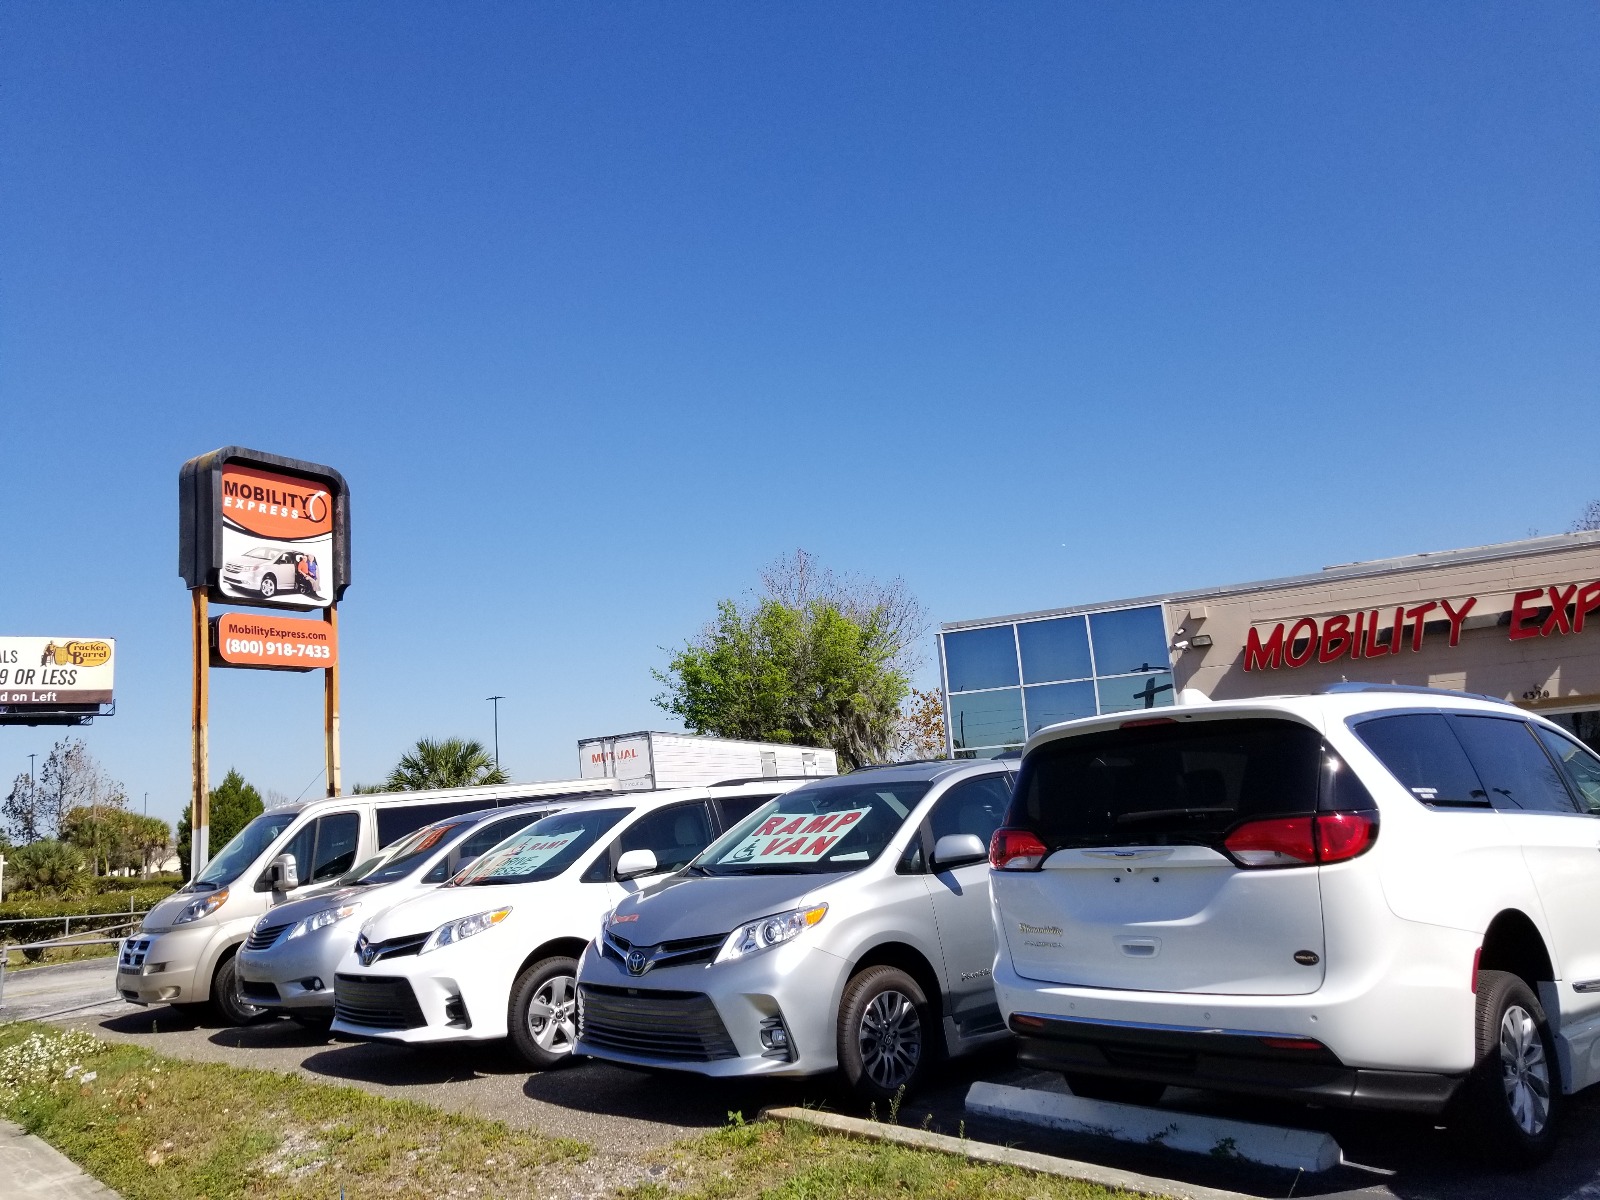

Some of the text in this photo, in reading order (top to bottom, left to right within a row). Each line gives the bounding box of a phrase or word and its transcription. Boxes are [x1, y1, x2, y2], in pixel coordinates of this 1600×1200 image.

[224, 480, 309, 510] MOBILITY
[224, 497, 299, 519] EXPRESS
[228, 623, 327, 640] MobilityExpress.com
[1243, 597, 1478, 672] MOBILITY
[66, 641, 107, 657] Cracker
[72, 651, 107, 665] Barrel
[225, 638, 330, 659] (800) 918-7433
[14, 668, 36, 685] OR
[41, 669, 78, 685] LESS
[12, 693, 28, 702] on
[31, 691, 57, 702] Left
[591, 748, 638, 764] MUTUAL
[751, 811, 862, 837] RAMP
[760, 835, 840, 856] VAN
